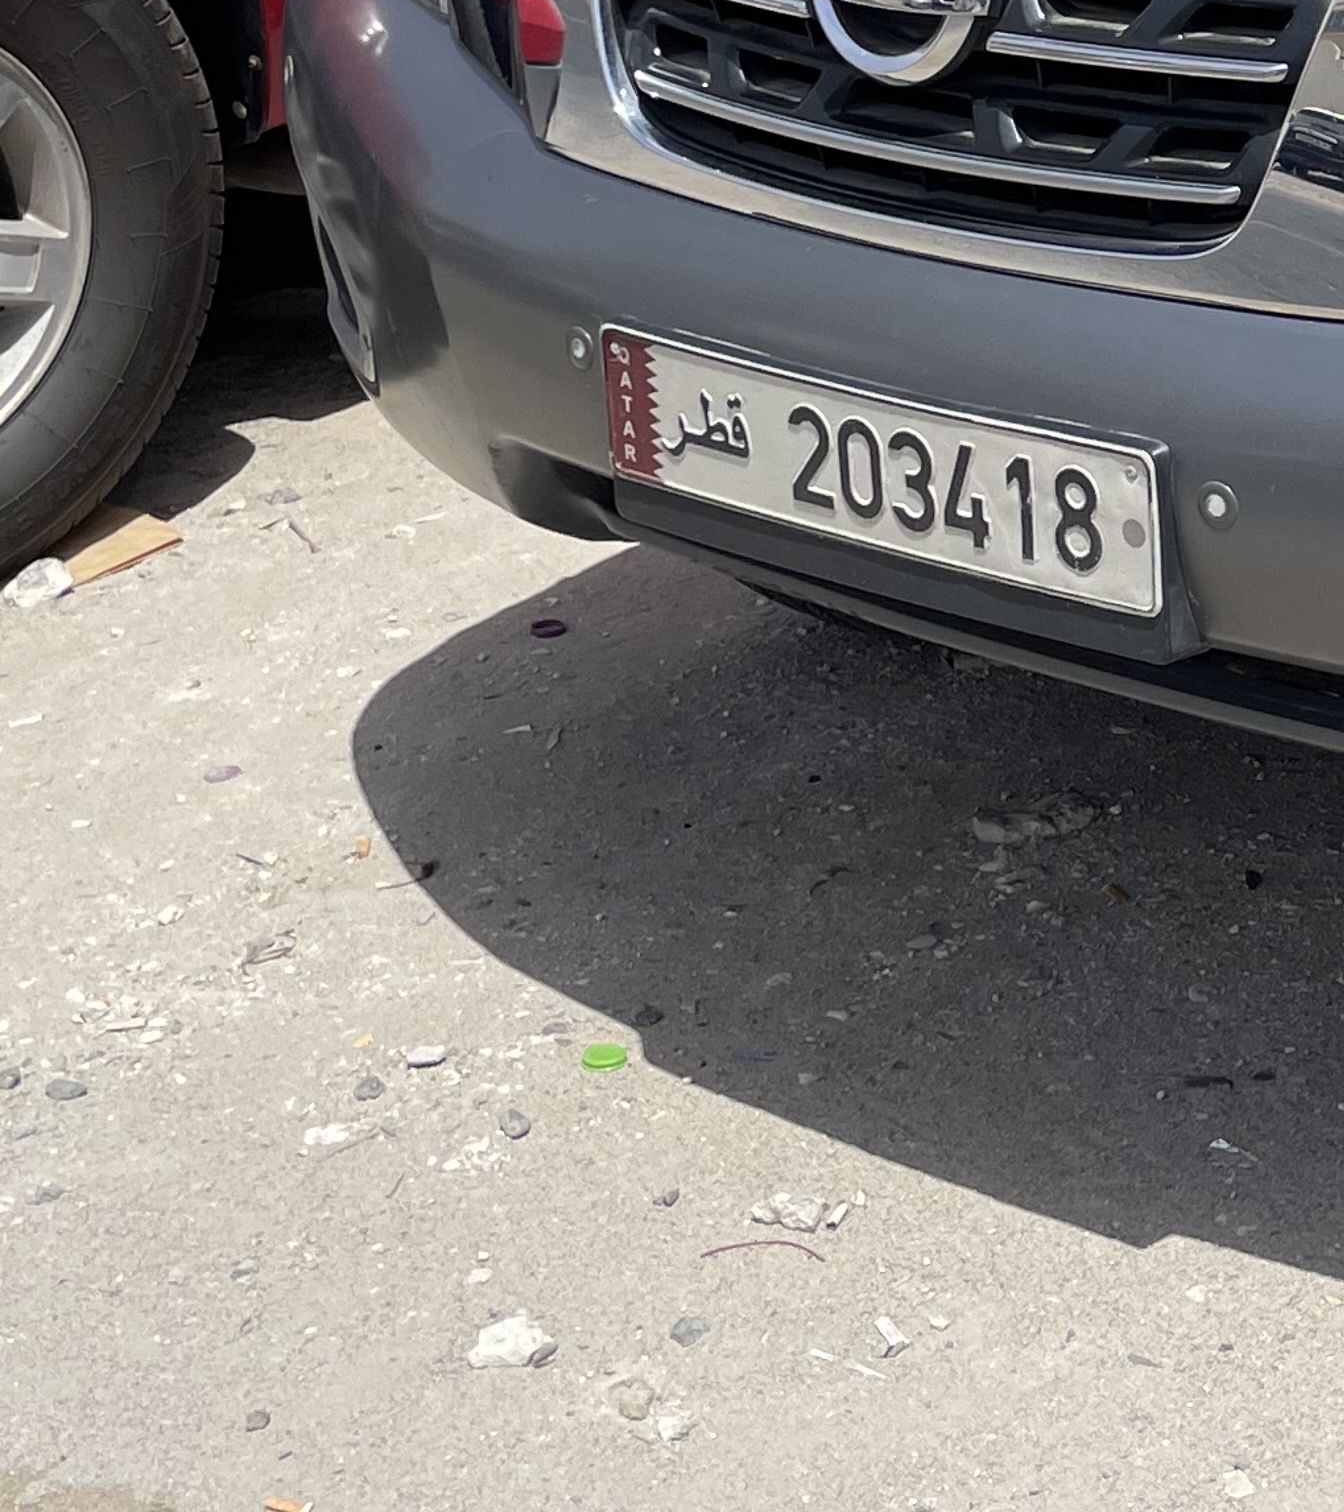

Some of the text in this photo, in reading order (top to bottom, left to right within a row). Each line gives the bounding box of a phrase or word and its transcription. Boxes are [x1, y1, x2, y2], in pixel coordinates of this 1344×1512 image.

[611, 345, 637, 463] QATAR
[660, 388, 752, 459] قطر
[786, 402, 1102, 572] 203418
